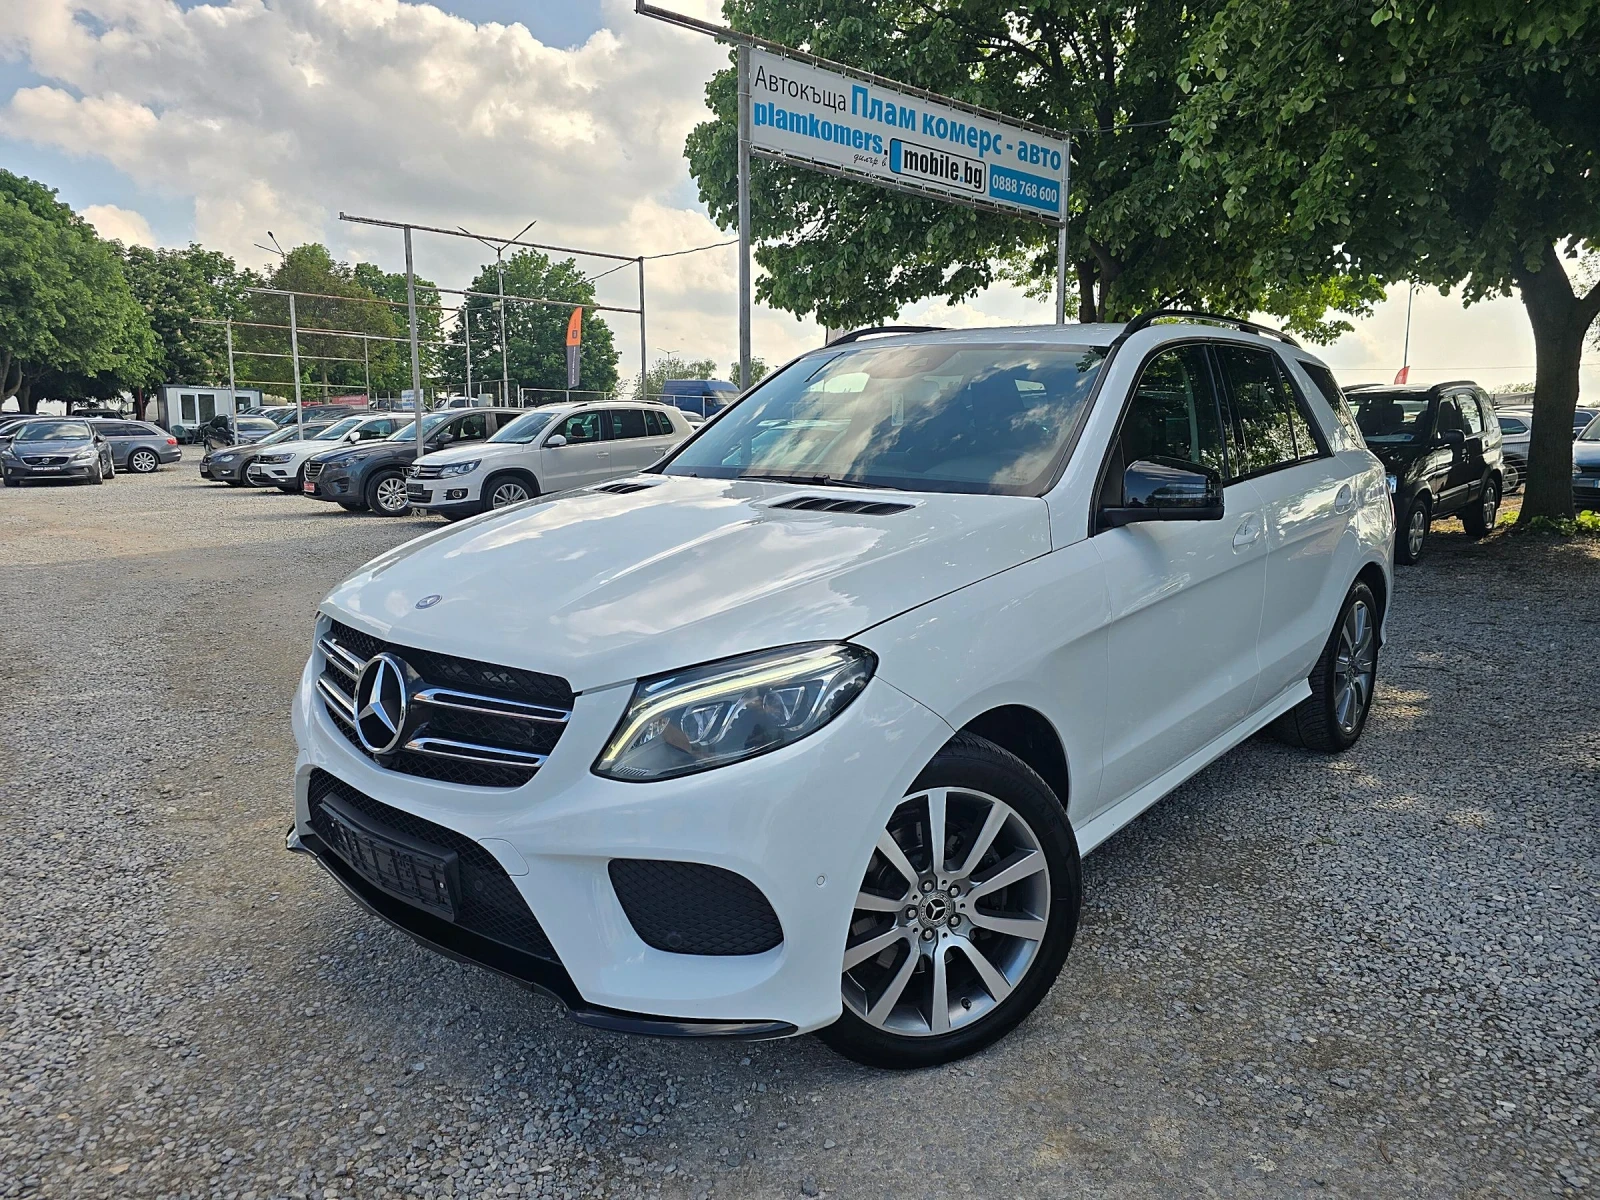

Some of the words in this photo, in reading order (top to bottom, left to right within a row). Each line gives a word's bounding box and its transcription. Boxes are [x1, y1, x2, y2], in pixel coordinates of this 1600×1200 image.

[755, 65, 846, 114] Автокъща
[852, 84, 916, 132] Плам
[922, 113, 1003, 158] комерс
[1017, 140, 1062, 171] авто
[903, 149, 983, 189] mobile.bg
[992, 174, 1018, 194] 0888
[1019, 181, 1038, 198] 768
[1039, 186, 1057, 203] 600
